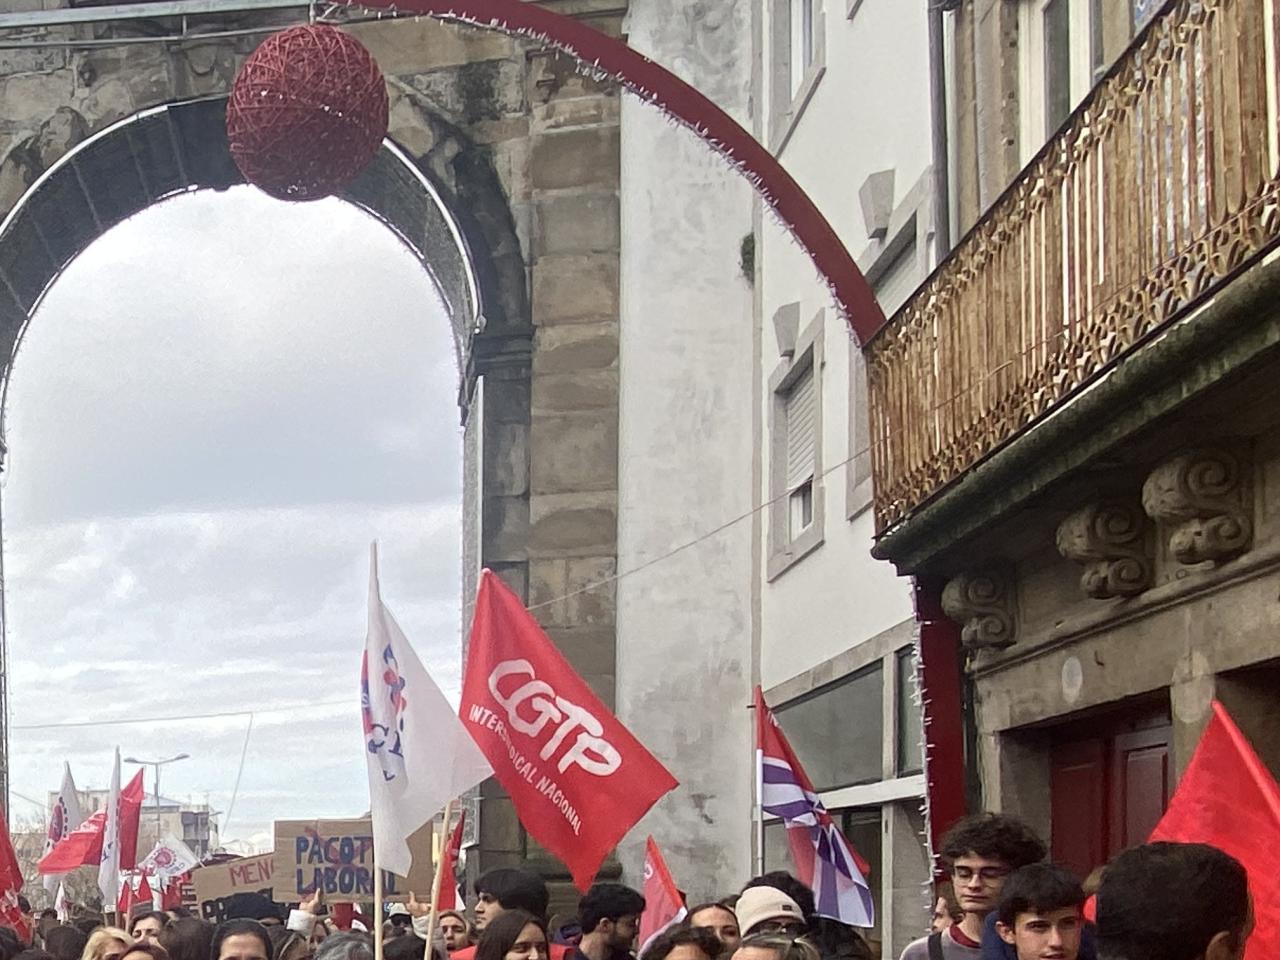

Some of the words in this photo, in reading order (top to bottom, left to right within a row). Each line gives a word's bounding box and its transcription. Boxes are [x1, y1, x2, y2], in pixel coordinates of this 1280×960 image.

[487, 658, 622, 777] CGTP
[535, 775, 581, 836] NACIONAL
[296, 836, 375, 864] PACOT
[229, 861, 274, 887] MEN
